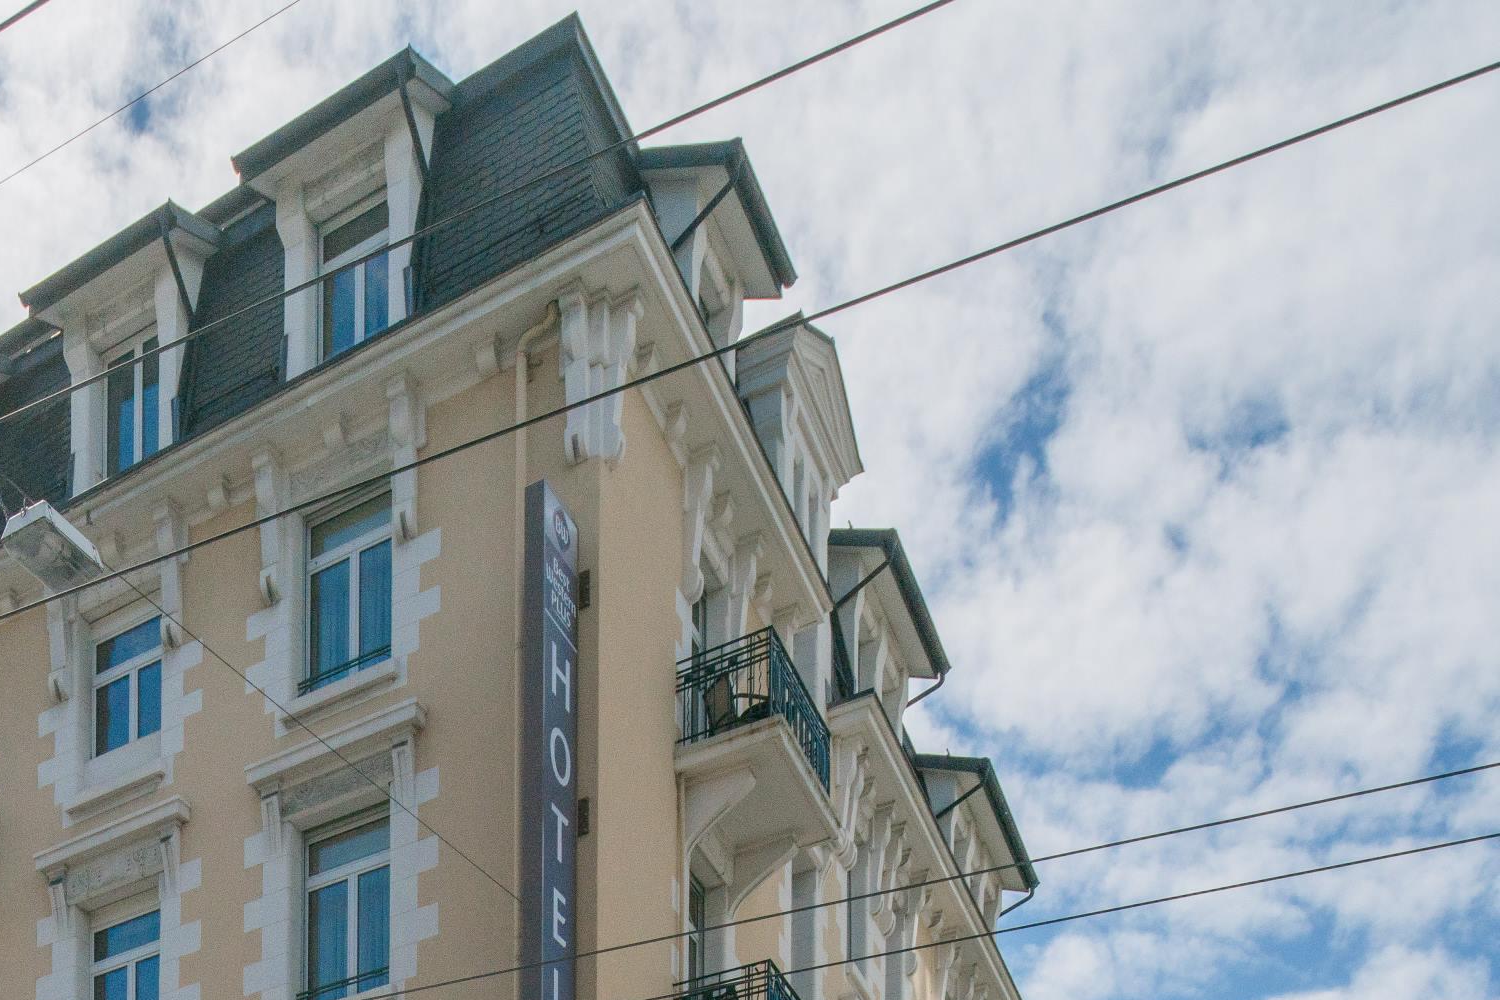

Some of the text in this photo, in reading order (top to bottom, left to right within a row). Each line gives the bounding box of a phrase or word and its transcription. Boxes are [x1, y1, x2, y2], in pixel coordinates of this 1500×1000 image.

[546, 562, 576, 618] Western
[553, 557, 570, 592] Best
[551, 589, 571, 628] PLUS
